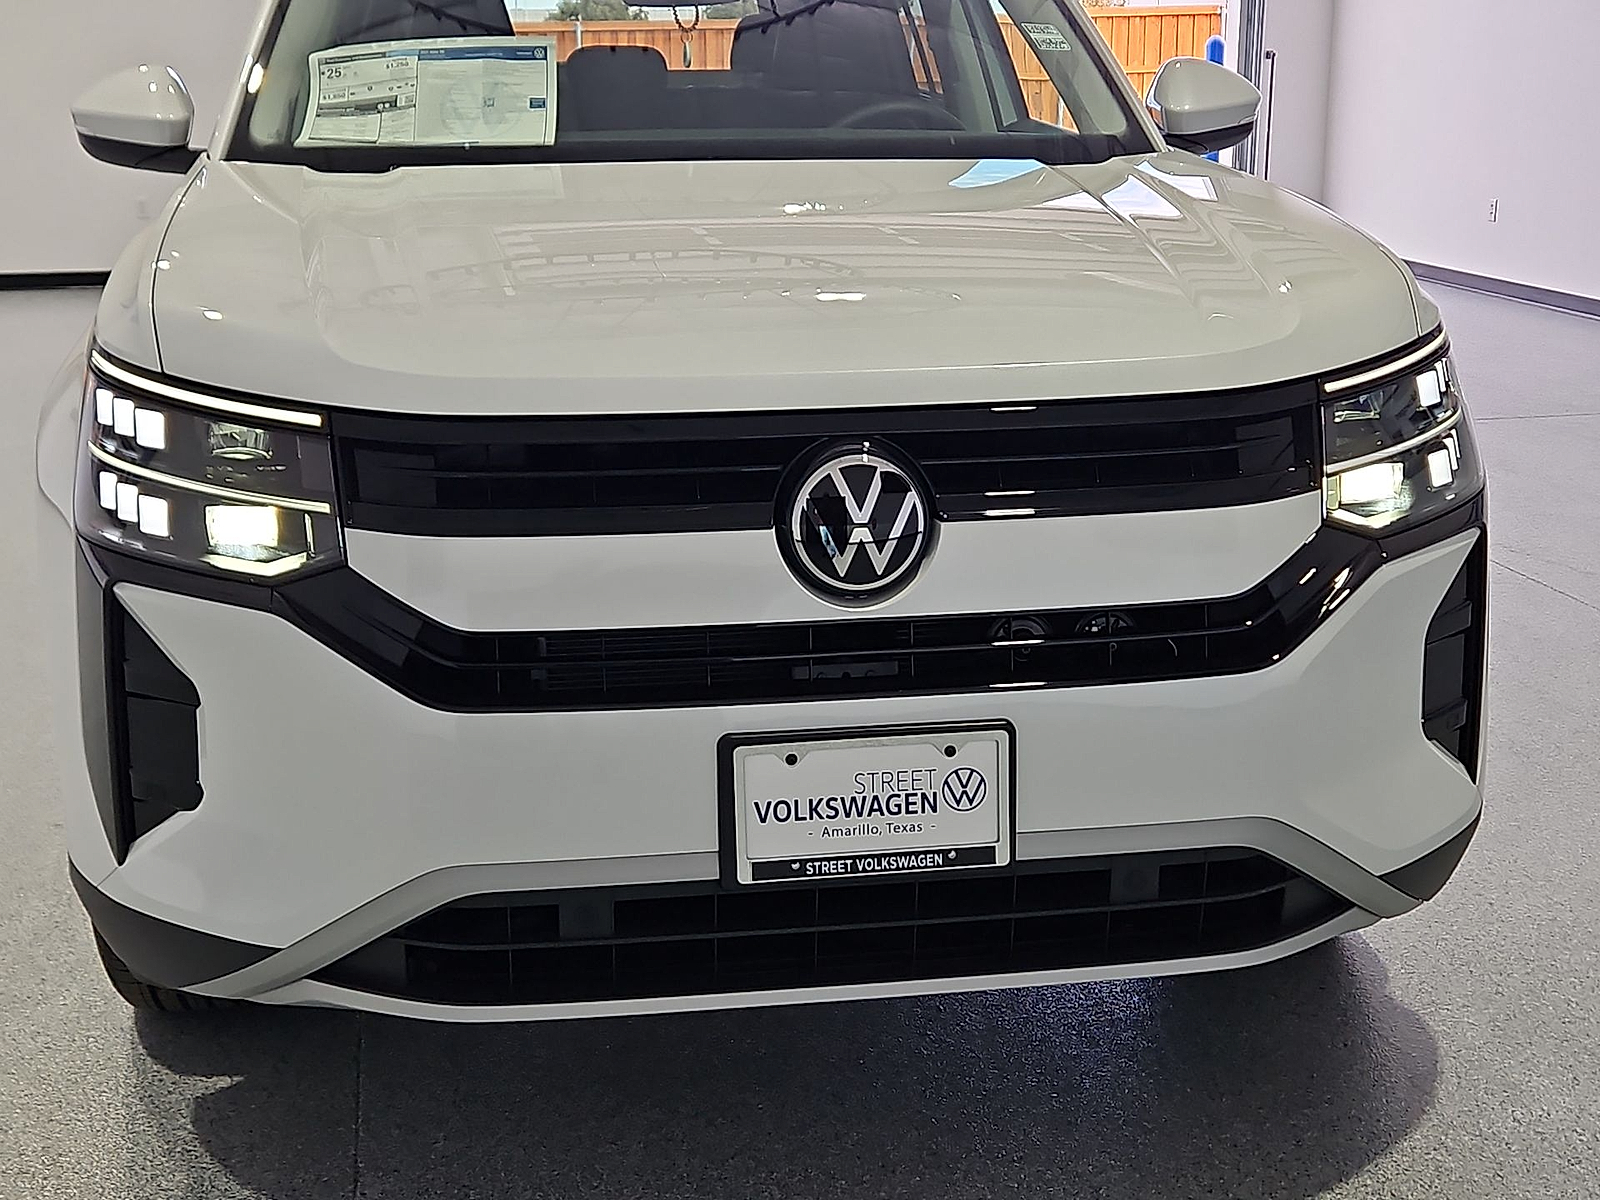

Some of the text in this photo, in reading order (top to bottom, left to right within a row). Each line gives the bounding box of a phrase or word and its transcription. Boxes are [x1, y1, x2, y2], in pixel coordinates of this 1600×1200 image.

[326, 68, 342, 79] 25
[794, 456, 923, 588] VW
[854, 768, 938, 795] STREET
[942, 767, 987, 812] VW
[753, 791, 938, 824] VOLKSWAGEN
[821, 823, 883, 838] Amarillo,
[886, 822, 923, 834] Texas
[806, 853, 943, 875] STREET VOLKSWAGEN
